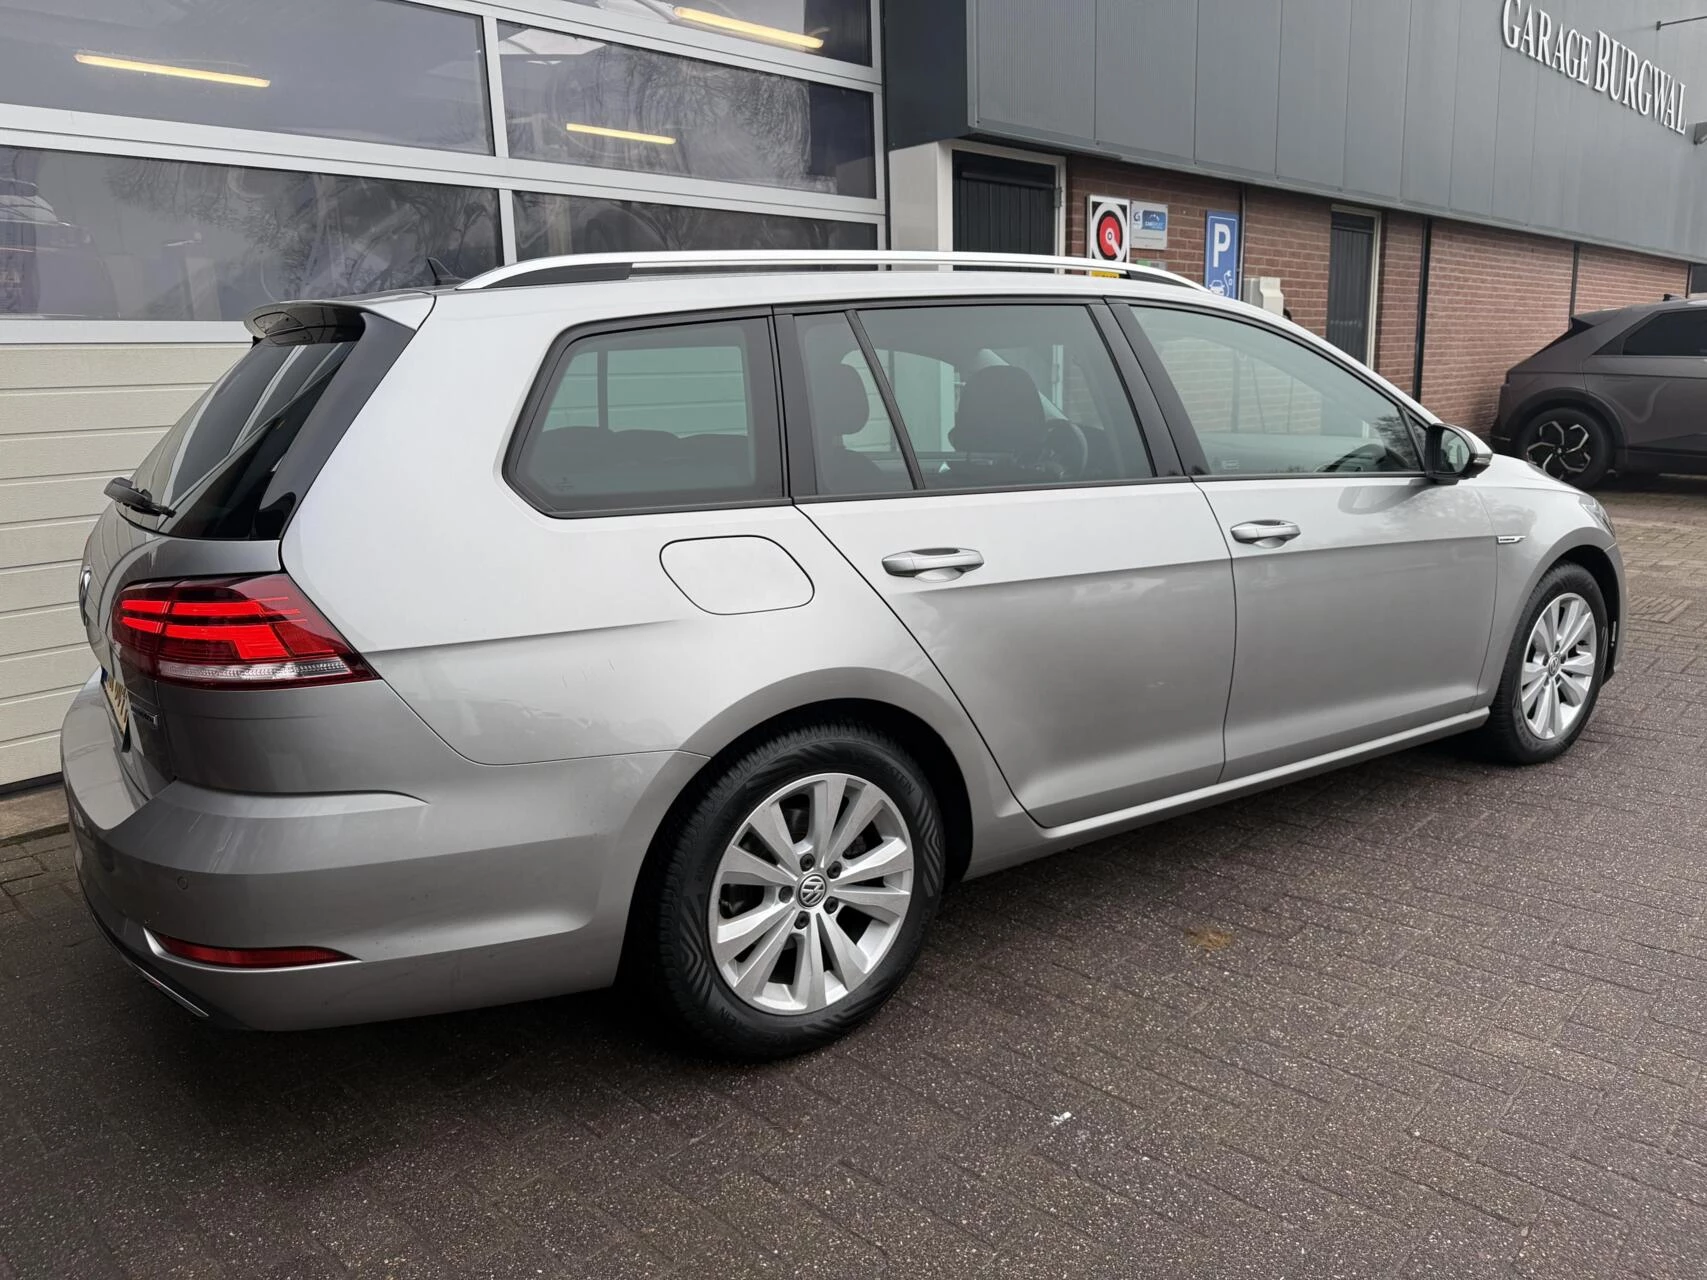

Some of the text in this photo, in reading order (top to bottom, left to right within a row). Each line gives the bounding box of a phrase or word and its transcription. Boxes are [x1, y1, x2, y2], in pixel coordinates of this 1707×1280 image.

[1502, 0, 1687, 135] GARAGE BURGWAL
[1213, 223, 1231, 268] P
